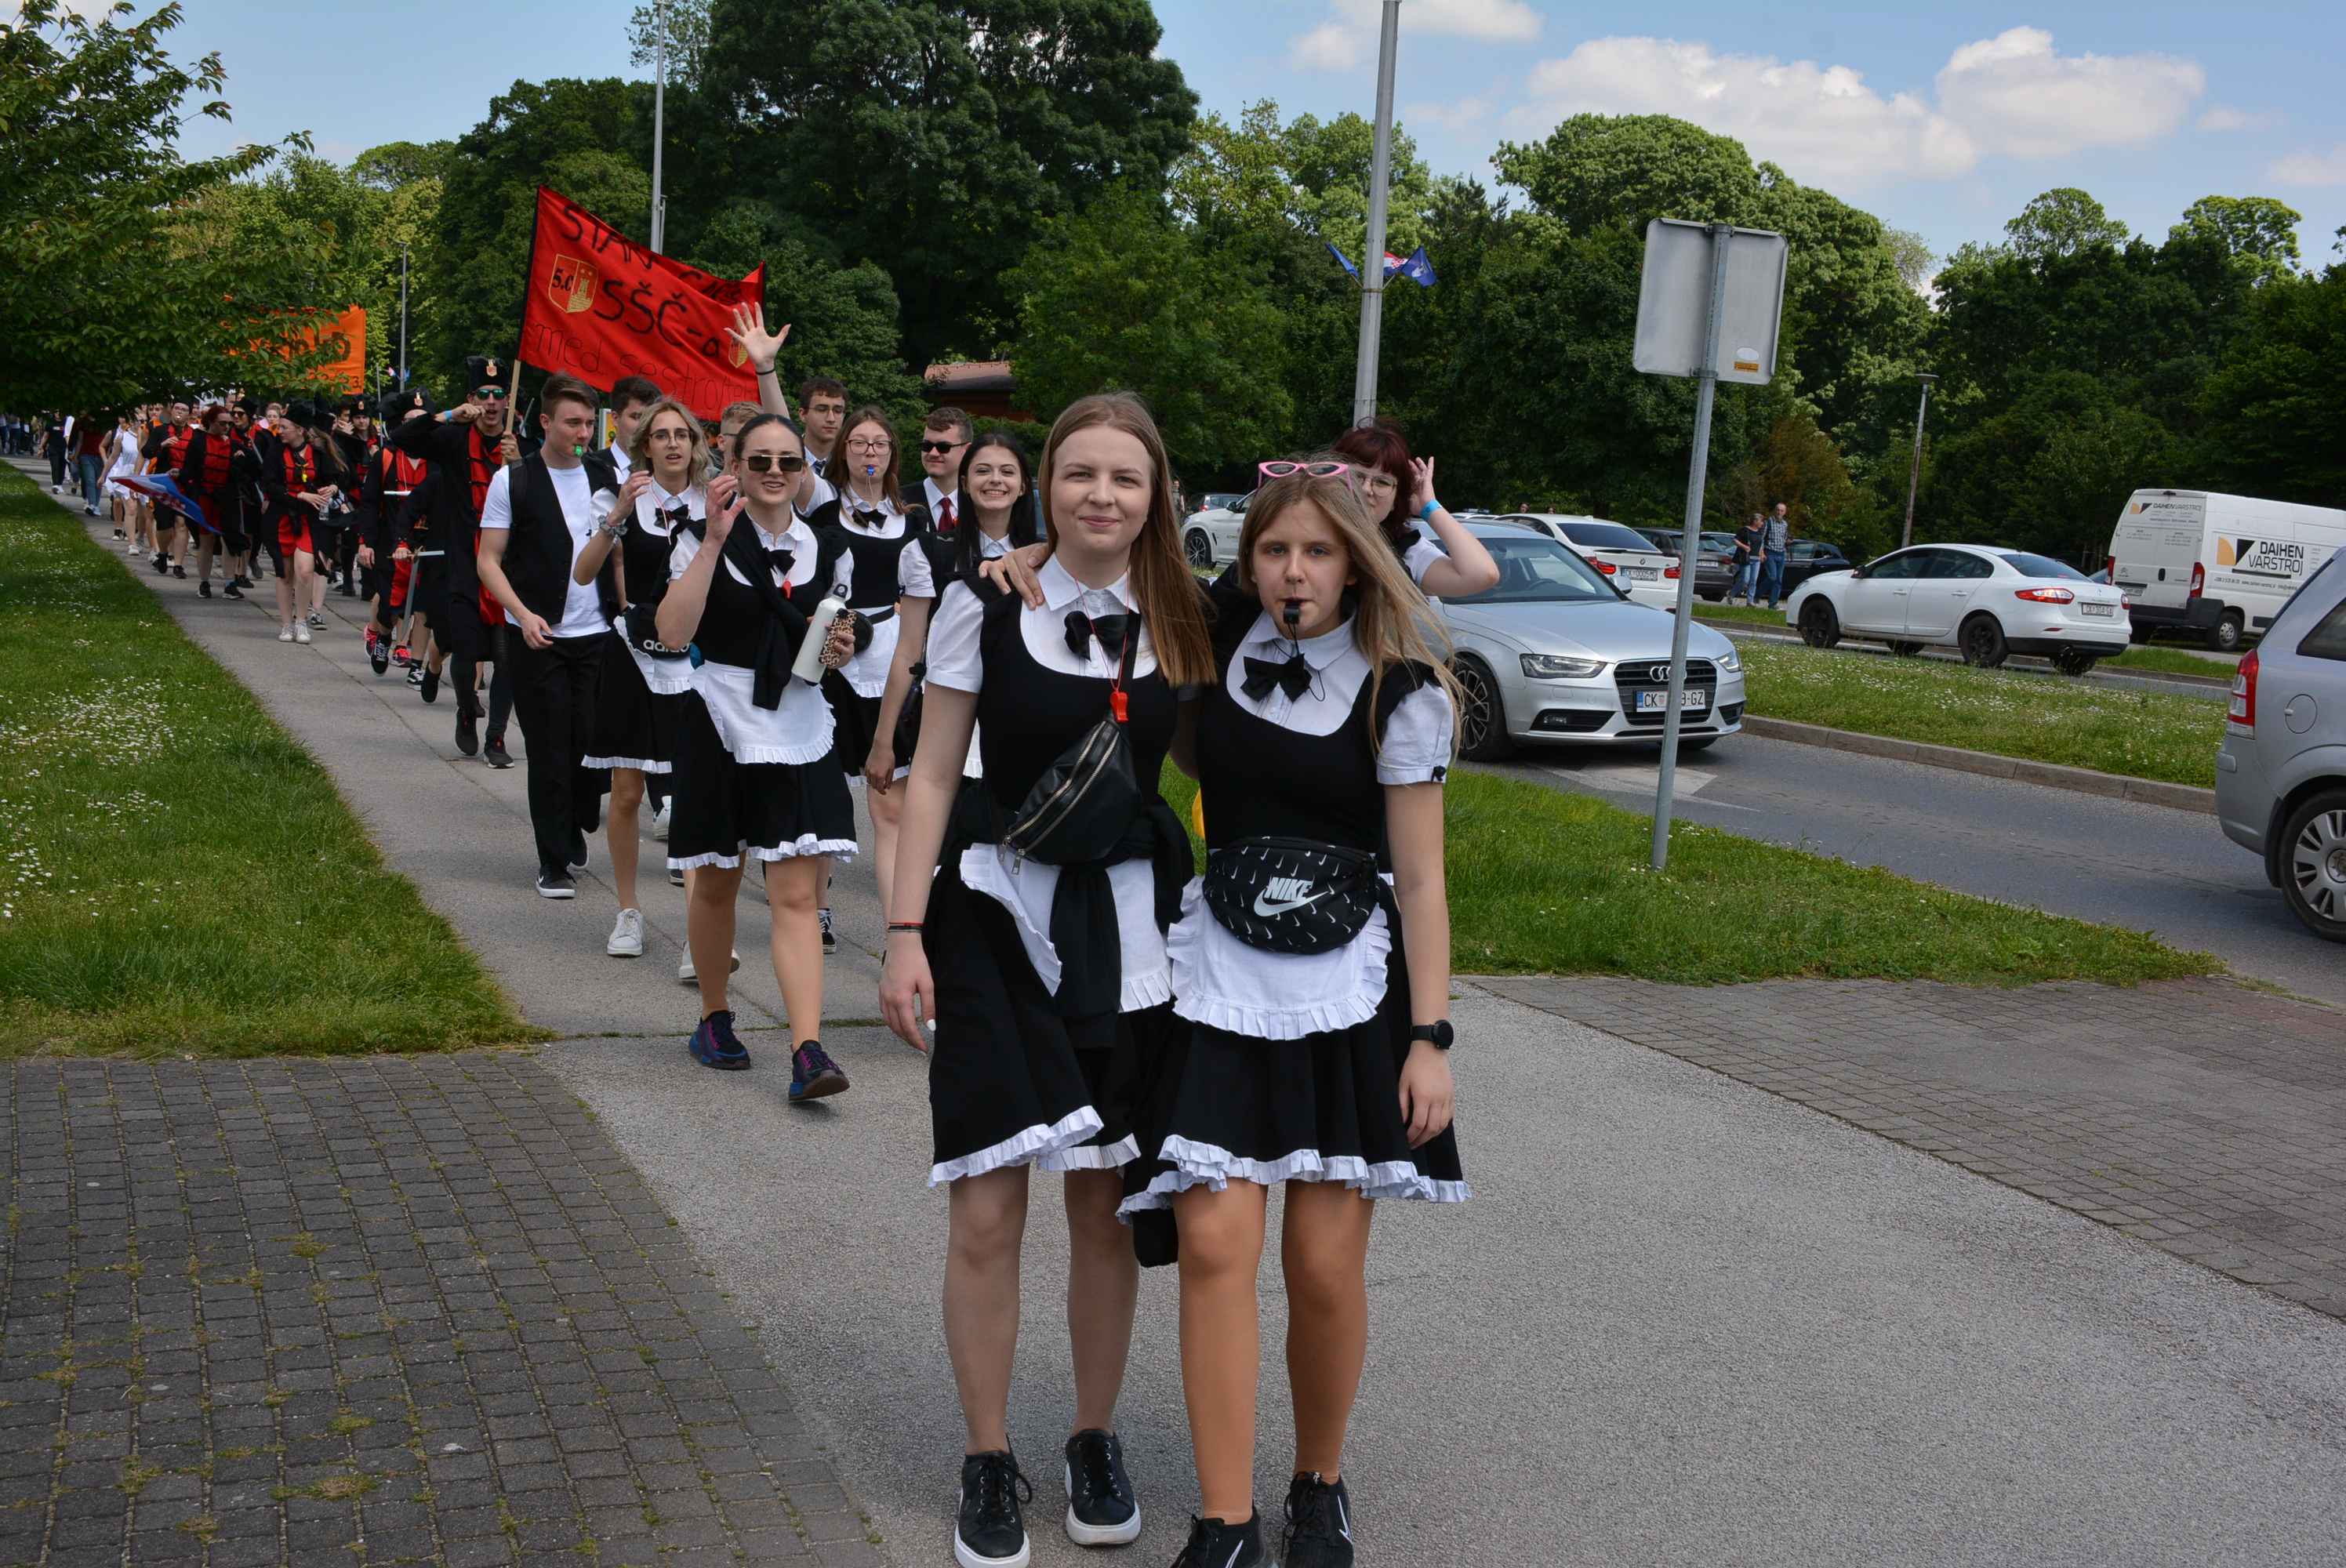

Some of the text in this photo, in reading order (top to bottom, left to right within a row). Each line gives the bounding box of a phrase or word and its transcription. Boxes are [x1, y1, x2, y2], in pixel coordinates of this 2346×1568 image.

[2260, 541, 2304, 559] DAIHEN
[2248, 554, 2304, 576] VARSTROJ
[1264, 877, 1313, 902] NIKE
